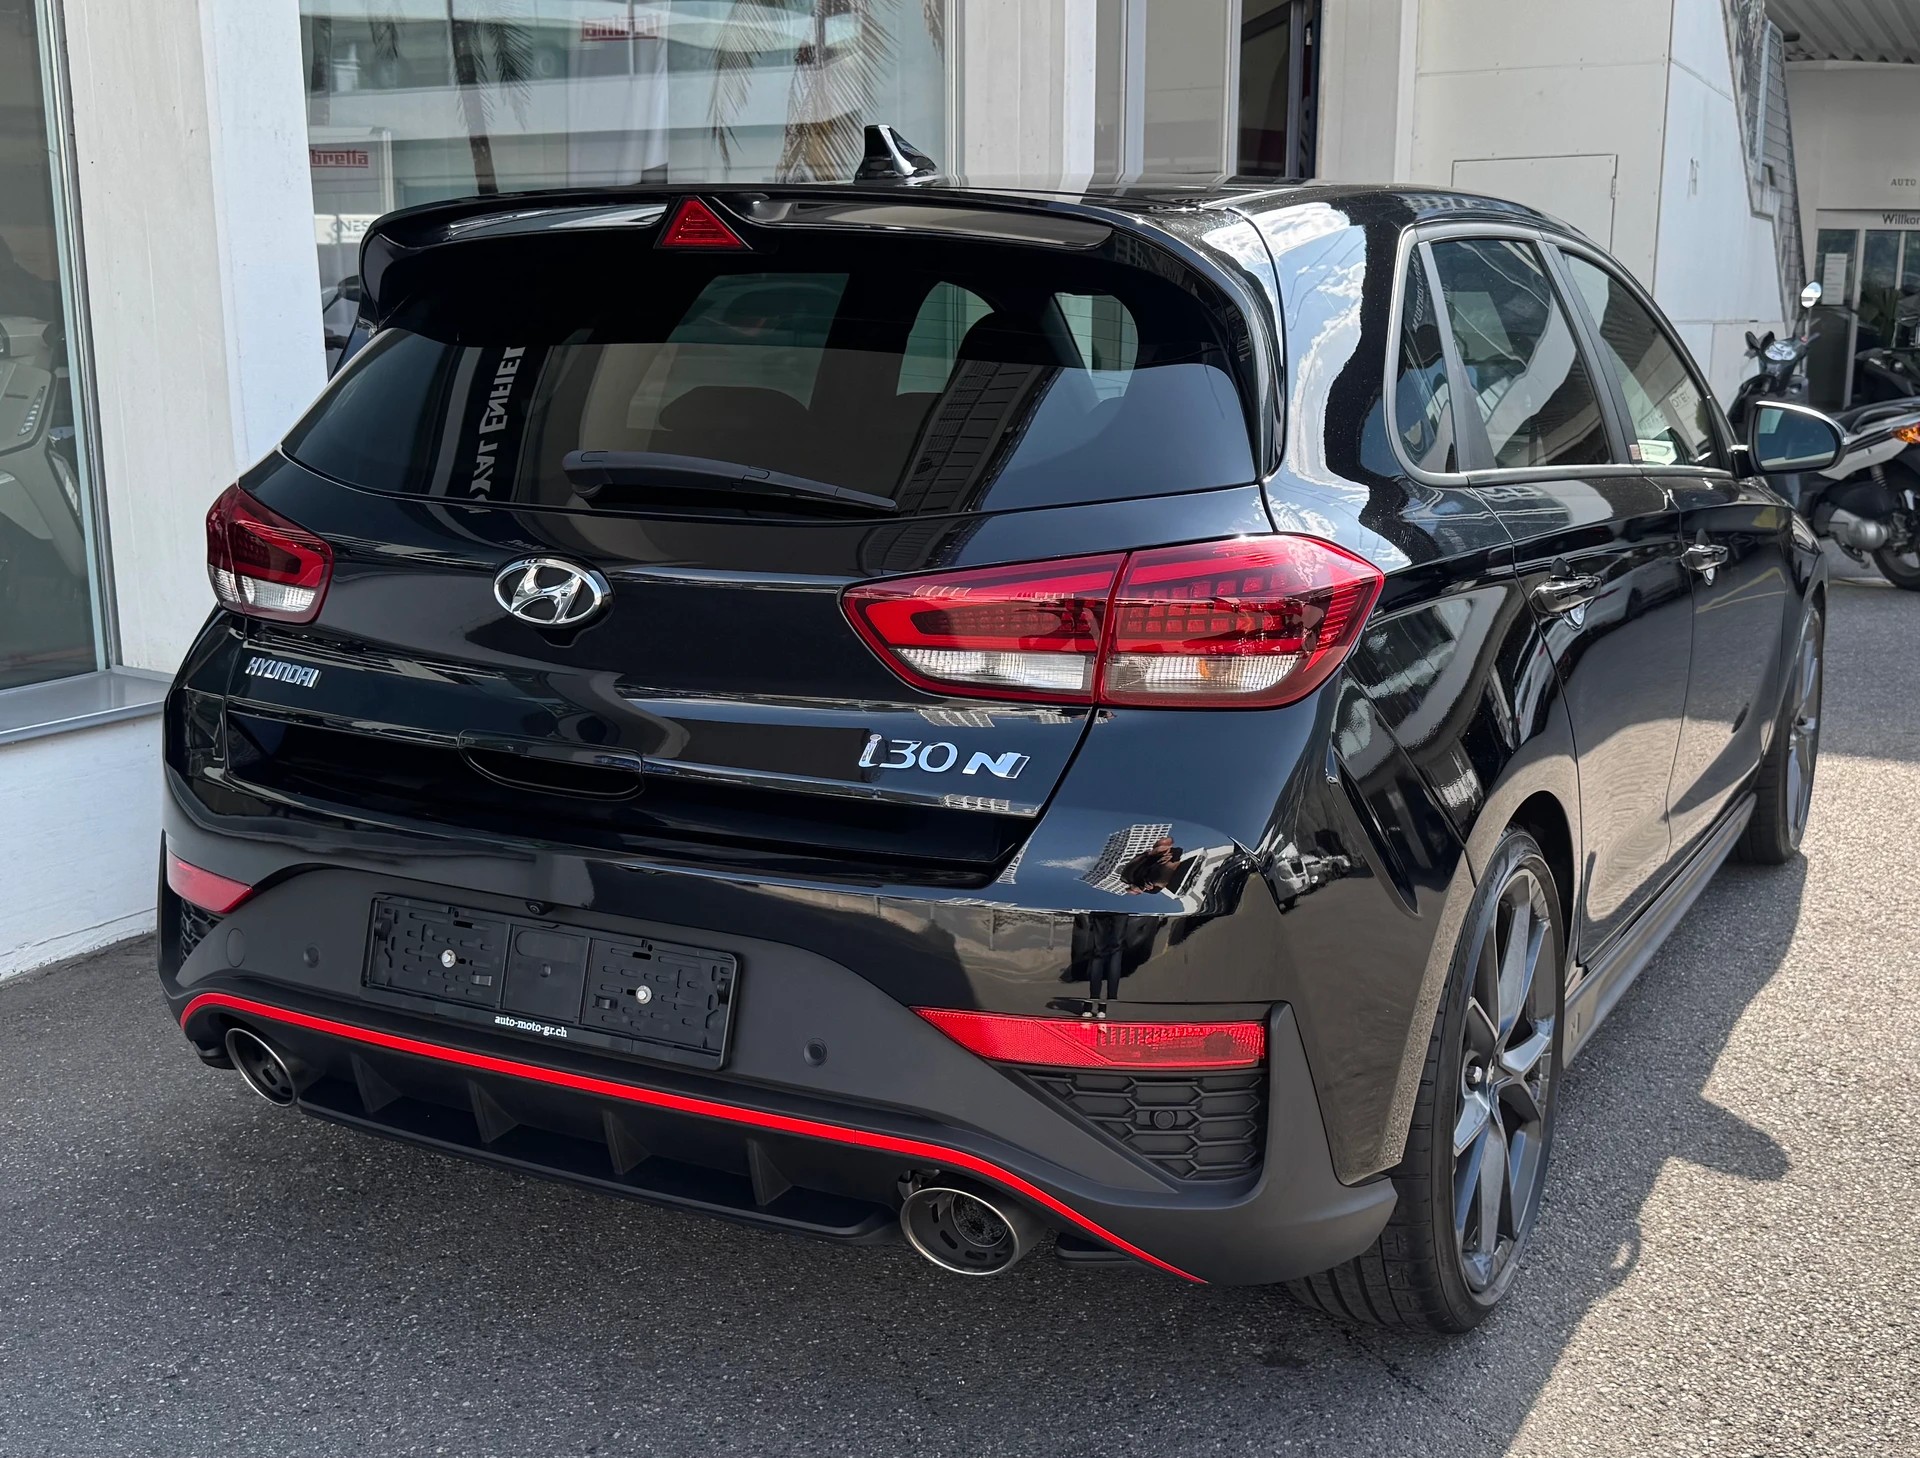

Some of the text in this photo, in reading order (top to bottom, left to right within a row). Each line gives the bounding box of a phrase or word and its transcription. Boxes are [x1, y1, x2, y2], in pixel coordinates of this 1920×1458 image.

[1890, 178, 1917, 186] AUTO
[245, 656, 321, 688] HYUNDAI
[858, 733, 1031, 780] i30 N
[494, 1015, 568, 1038] auto-moto-gr.ch
